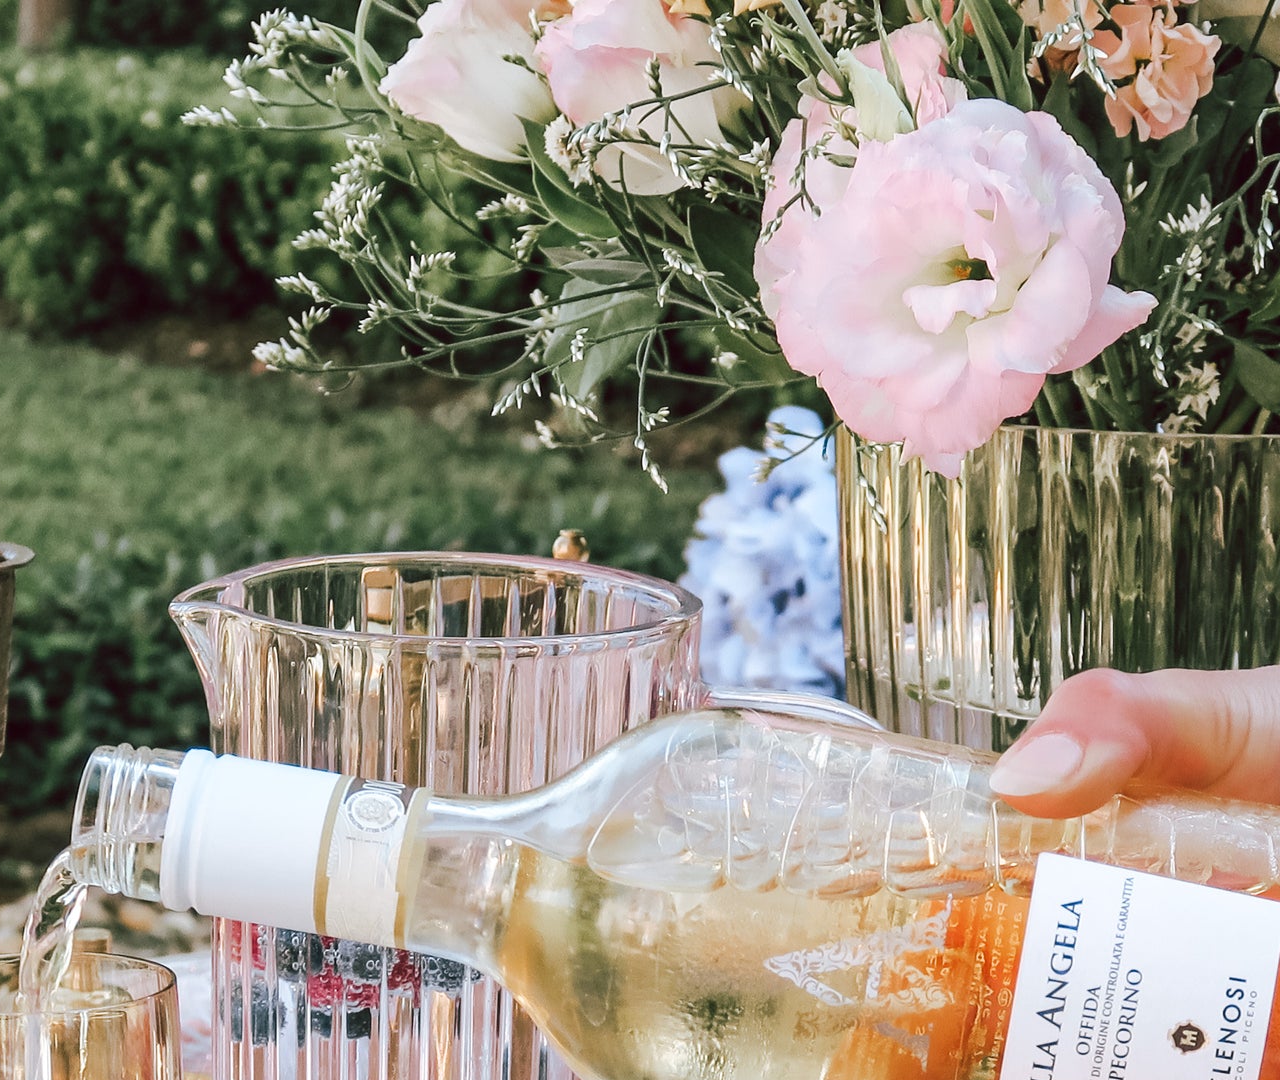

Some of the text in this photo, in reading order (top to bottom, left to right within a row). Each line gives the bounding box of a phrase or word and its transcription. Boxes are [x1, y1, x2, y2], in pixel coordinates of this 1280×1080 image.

[1117, 878, 1134, 931] GARANTITA
[1036, 898, 1083, 1032] ANGELA
[1102, 942, 1123, 1017] CONTROLLATA
[1076, 986, 1101, 1055] OFFIDA
[1094, 1020, 1110, 1064] ORIGINE
[1108, 969, 1142, 1080] PECORINO
[1241, 990, 1258, 1043] PICENO
[1090, 1064, 1102, 1077] DI
